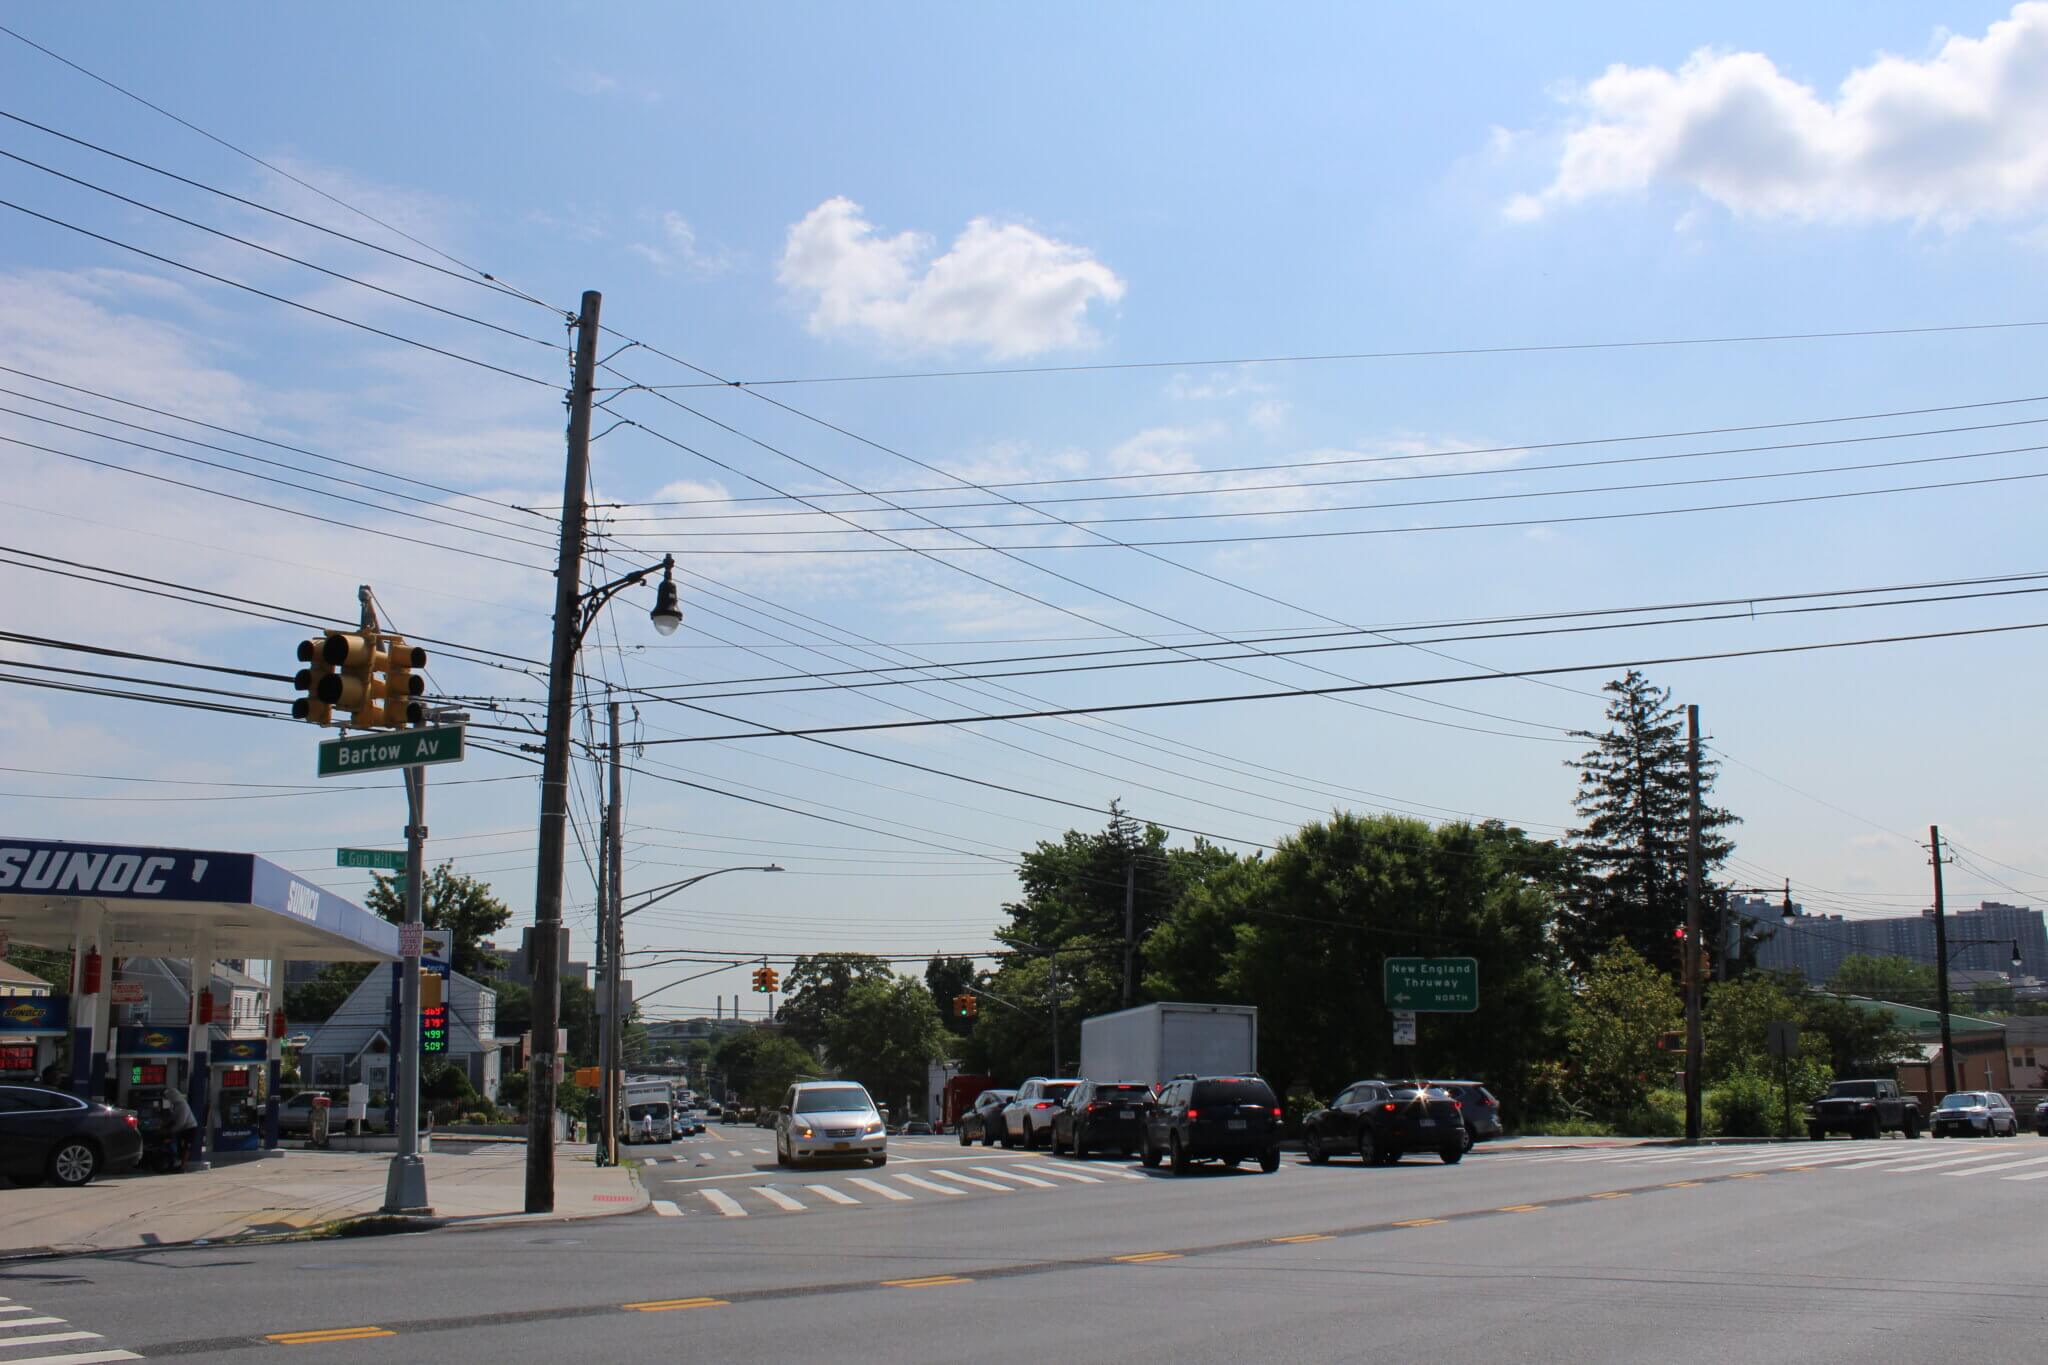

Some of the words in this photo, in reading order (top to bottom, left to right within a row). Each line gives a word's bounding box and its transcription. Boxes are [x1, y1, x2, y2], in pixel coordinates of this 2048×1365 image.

[338, 744, 401, 766] Bartow
[415, 738, 439, 757] Av
[339, 851, 345, 865] E
[349, 852, 369, 866] Gun
[374, 853, 392, 867] Hill
[0, 848, 208, 894] SUNOC
[1392, 964, 1415, 973] New
[1421, 964, 1470, 975] England
[1404, 978, 1458, 988] Thruway
